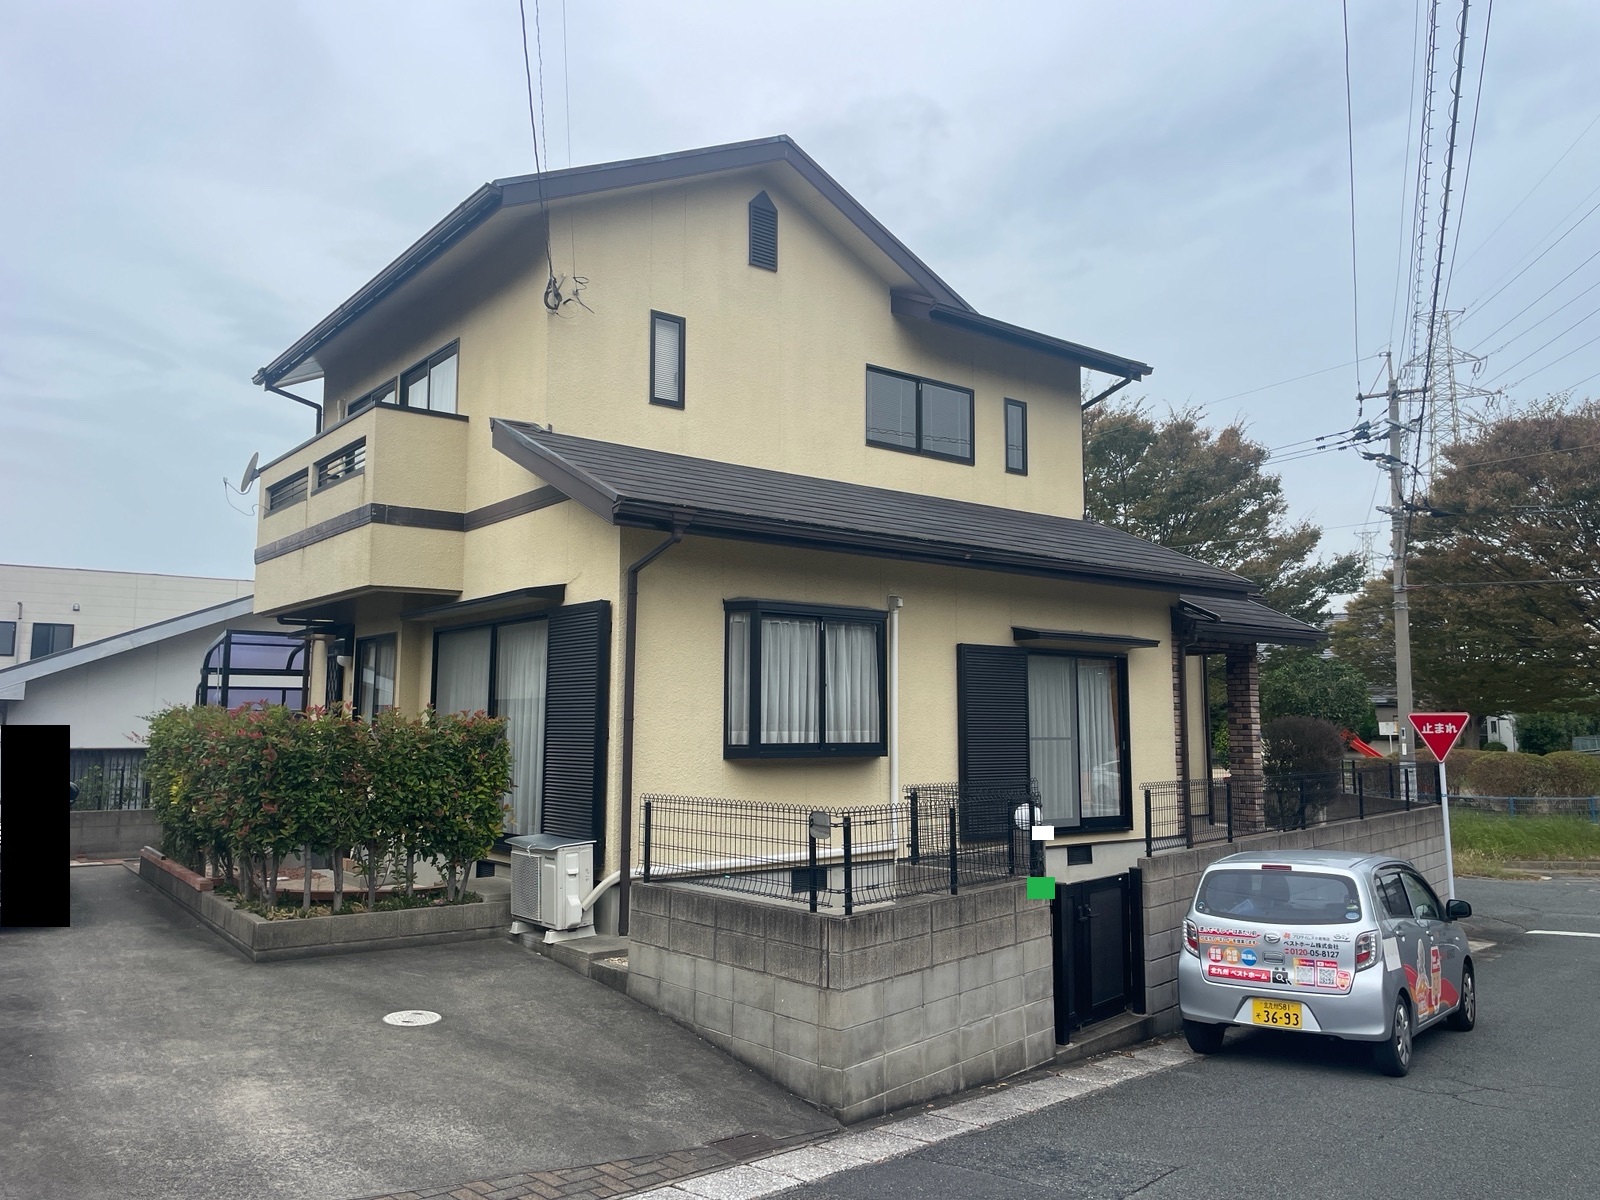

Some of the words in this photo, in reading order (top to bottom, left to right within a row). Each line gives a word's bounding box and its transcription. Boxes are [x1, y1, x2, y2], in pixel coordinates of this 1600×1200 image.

[1421, 722, 1458, 734] 止まれ
[1283, 941, 1340, 950] ベストホーム株式会社
[1290, 948, 1340, 958] 0120-05-8127
[1210, 967, 1229, 976] 北九州
[1230, 969, 1267, 979] ベストホーム
[1263, 1010, 1299, 1026] 36-93
